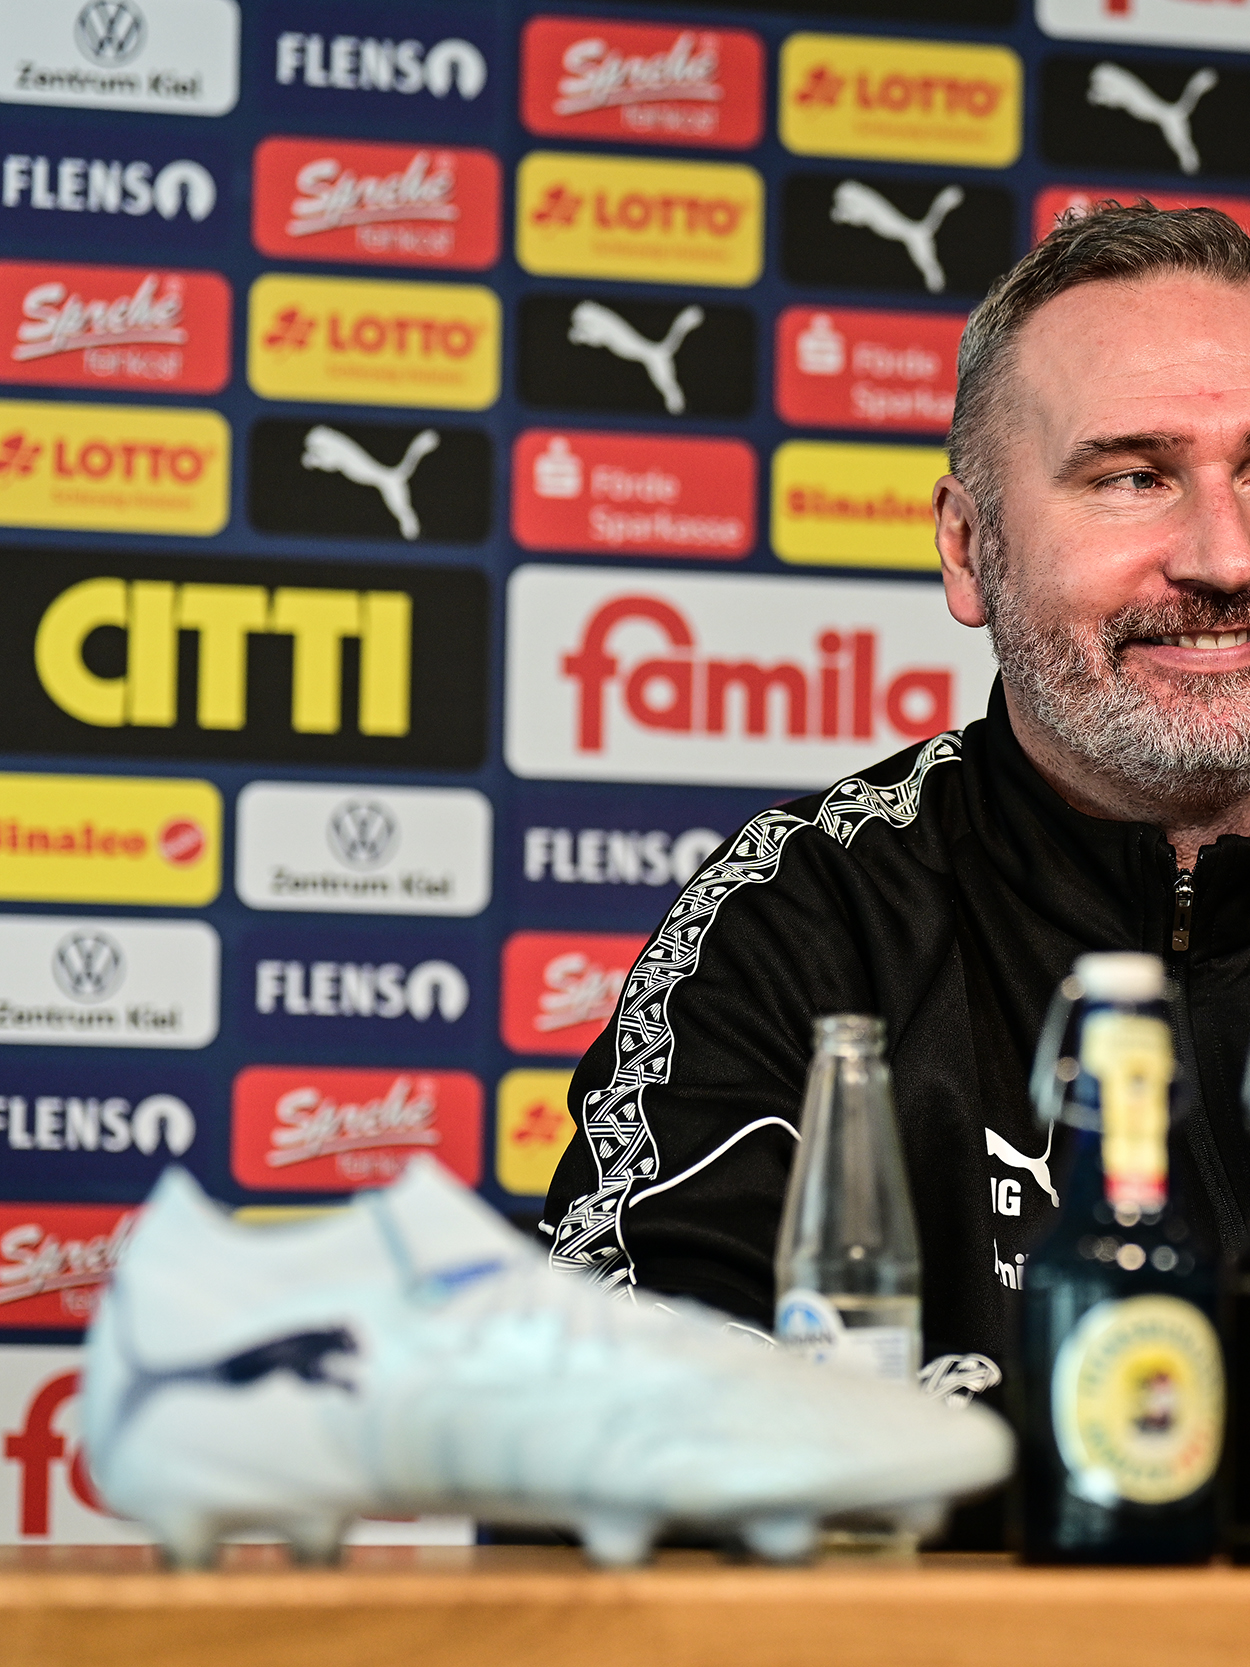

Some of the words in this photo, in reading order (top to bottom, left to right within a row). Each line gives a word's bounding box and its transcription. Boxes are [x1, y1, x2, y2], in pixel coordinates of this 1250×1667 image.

[147, 66, 201, 99] Kiel
[277, 31, 427, 94] FLENS
[855, 72, 1001, 119] LOTTO
[2, 155, 155, 217] FLENS
[594, 187, 744, 237] LOTTO
[328, 312, 478, 361] LOTTO
[52, 437, 204, 485] LOTTO
[34, 575, 414, 738] CITTI
[561, 591, 954, 757] famila
[0, 815, 148, 860] inalco
[523, 827, 675, 886] FLENS
[256, 959, 407, 1018] FLENS
